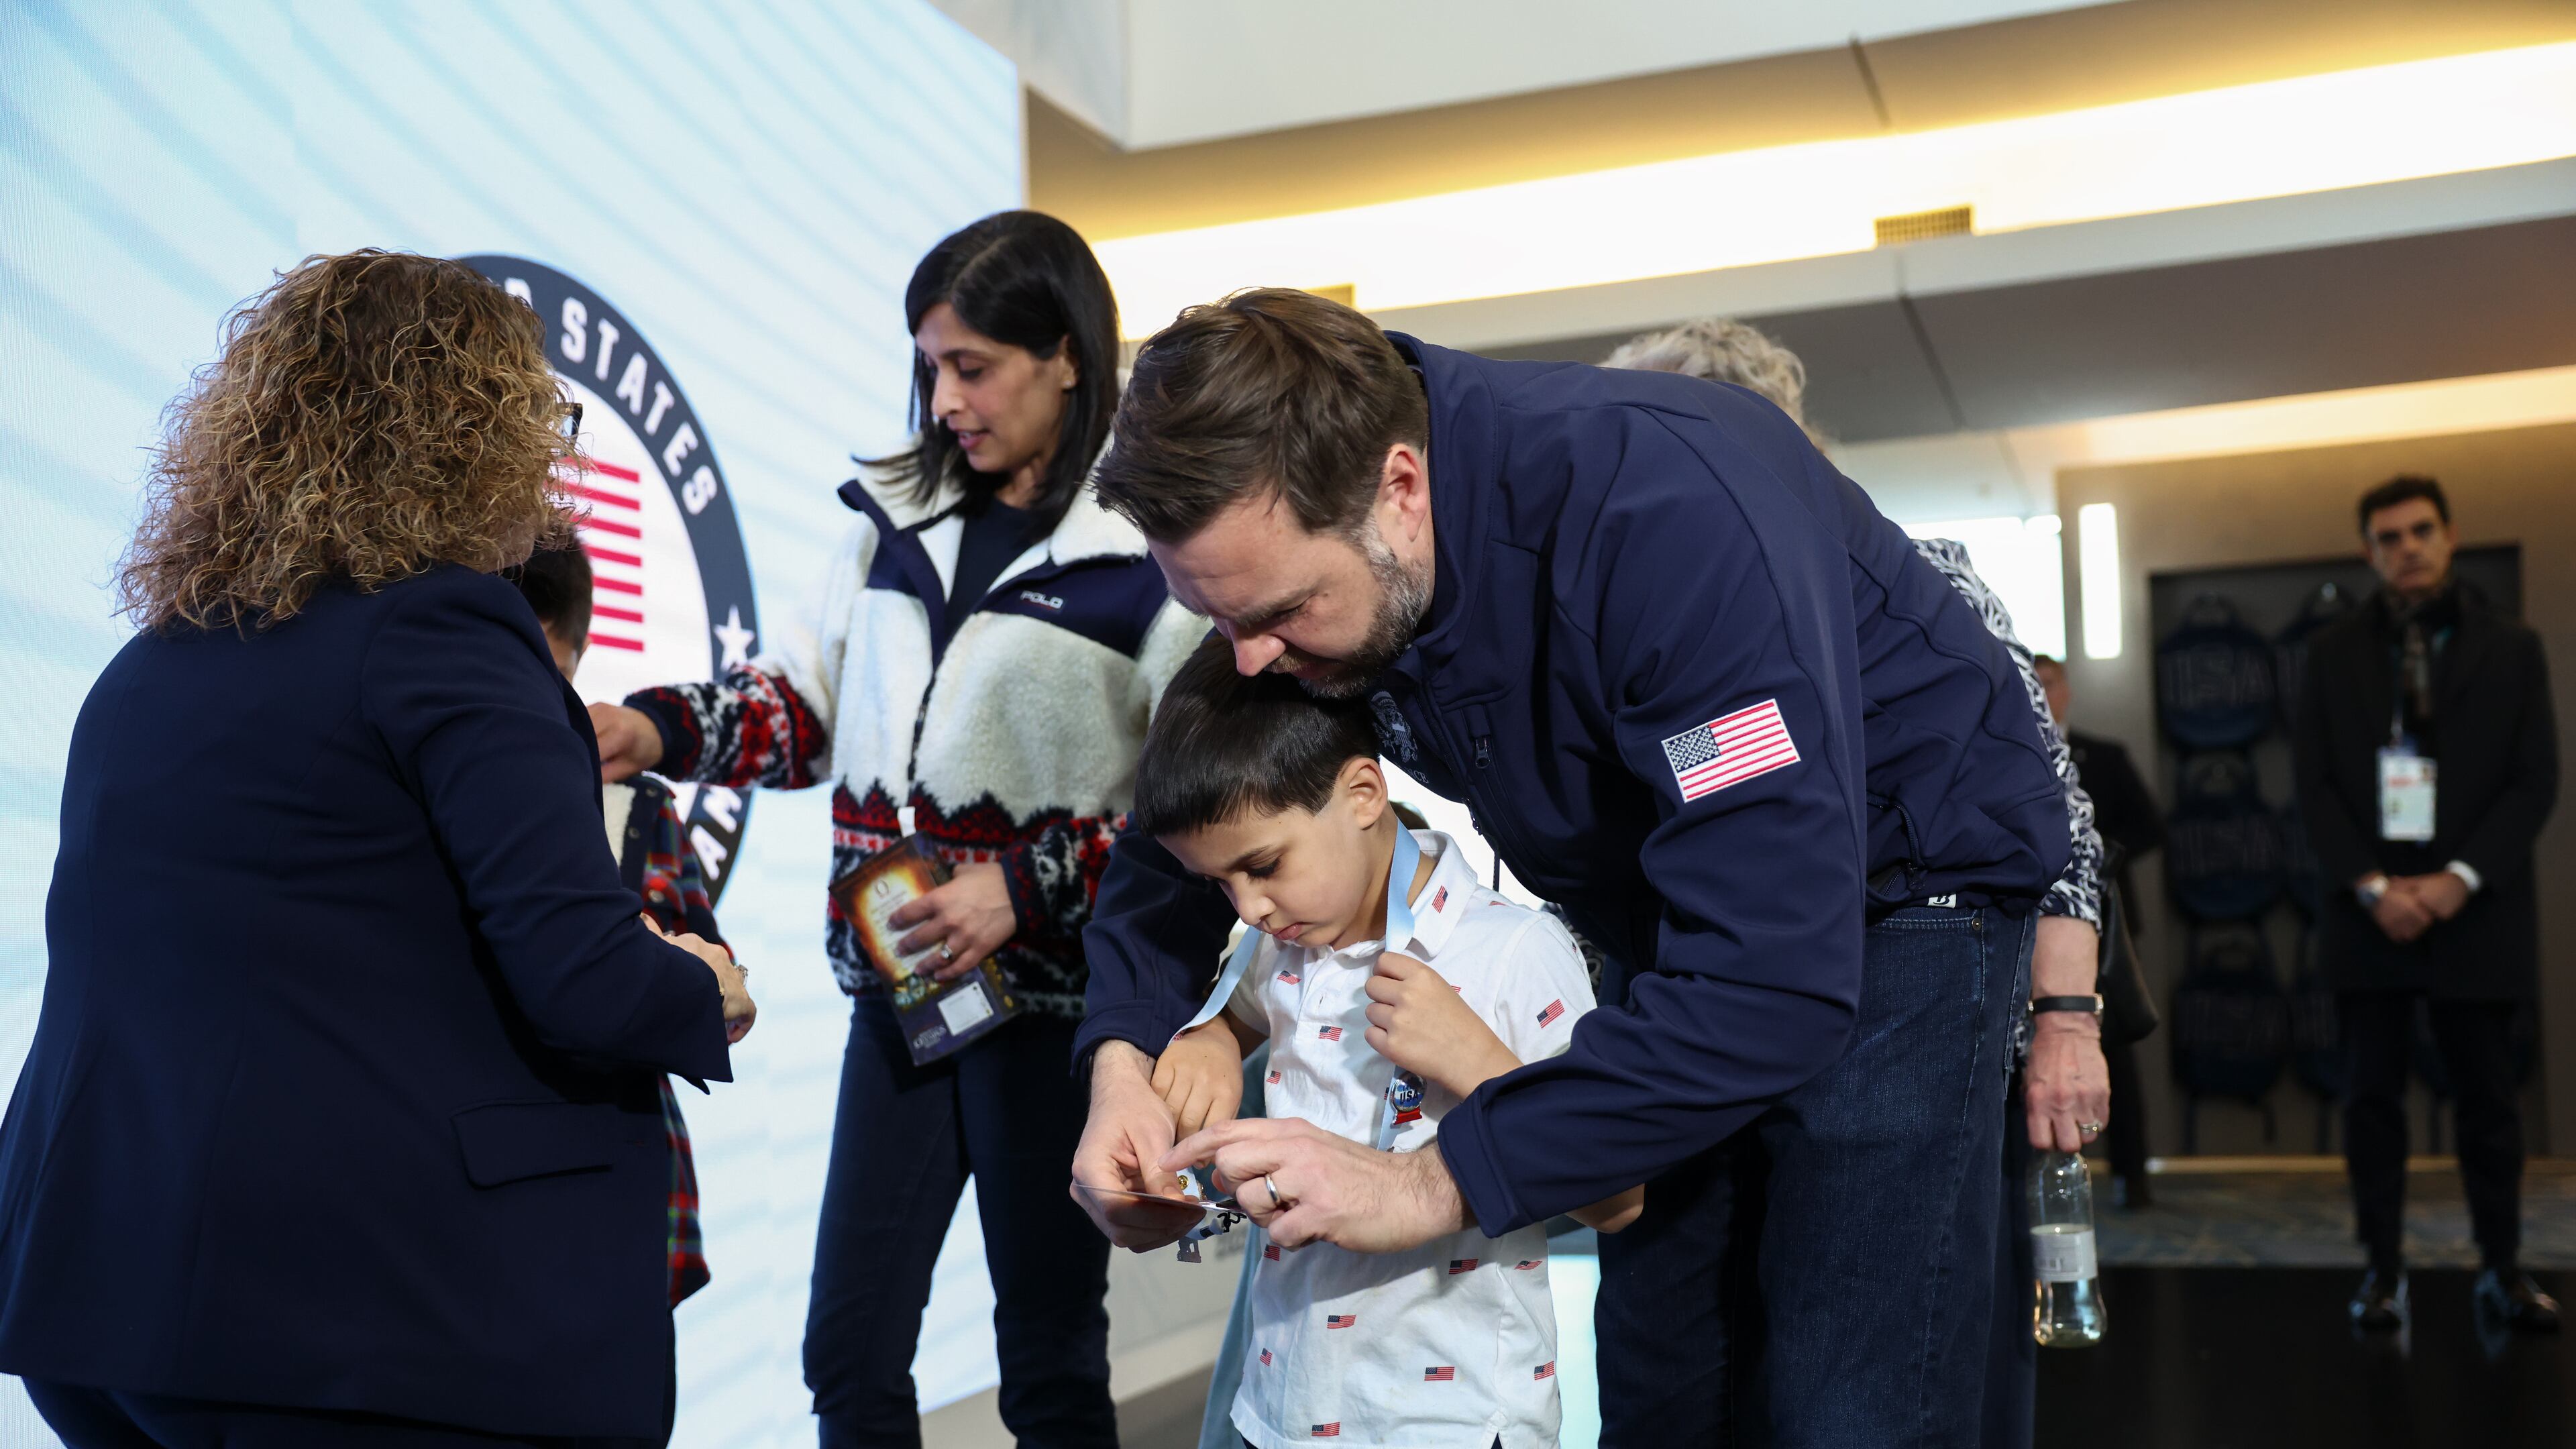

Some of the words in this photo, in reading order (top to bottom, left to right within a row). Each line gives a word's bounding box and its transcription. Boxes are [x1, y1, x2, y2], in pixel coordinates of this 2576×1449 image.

[561, 297, 717, 515] STATES
[1020, 590, 1063, 608] POLO
[1407, 768, 1429, 784] RCE
[690, 786, 743, 881] AM
[1400, 1089, 1418, 1104] USA
